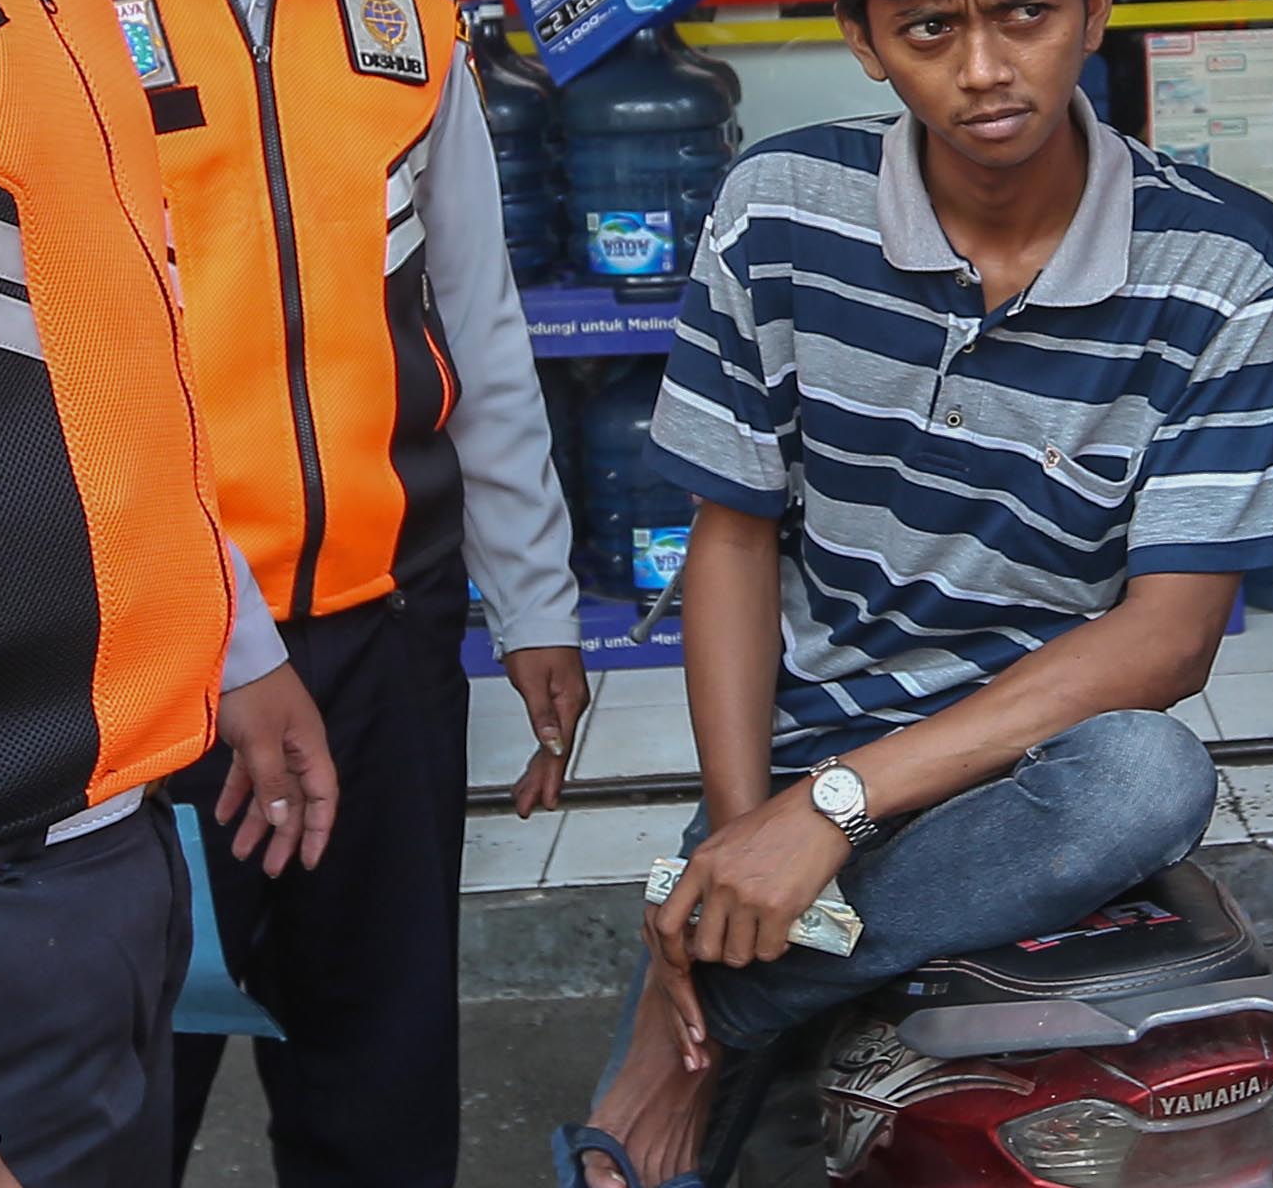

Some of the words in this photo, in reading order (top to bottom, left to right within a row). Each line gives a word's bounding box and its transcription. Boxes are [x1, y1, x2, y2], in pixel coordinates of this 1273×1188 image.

[359, 52, 422, 74] DISHUB
[581, 318, 623, 333] untuk
[1159, 1076, 1261, 1115] YAMAHA
